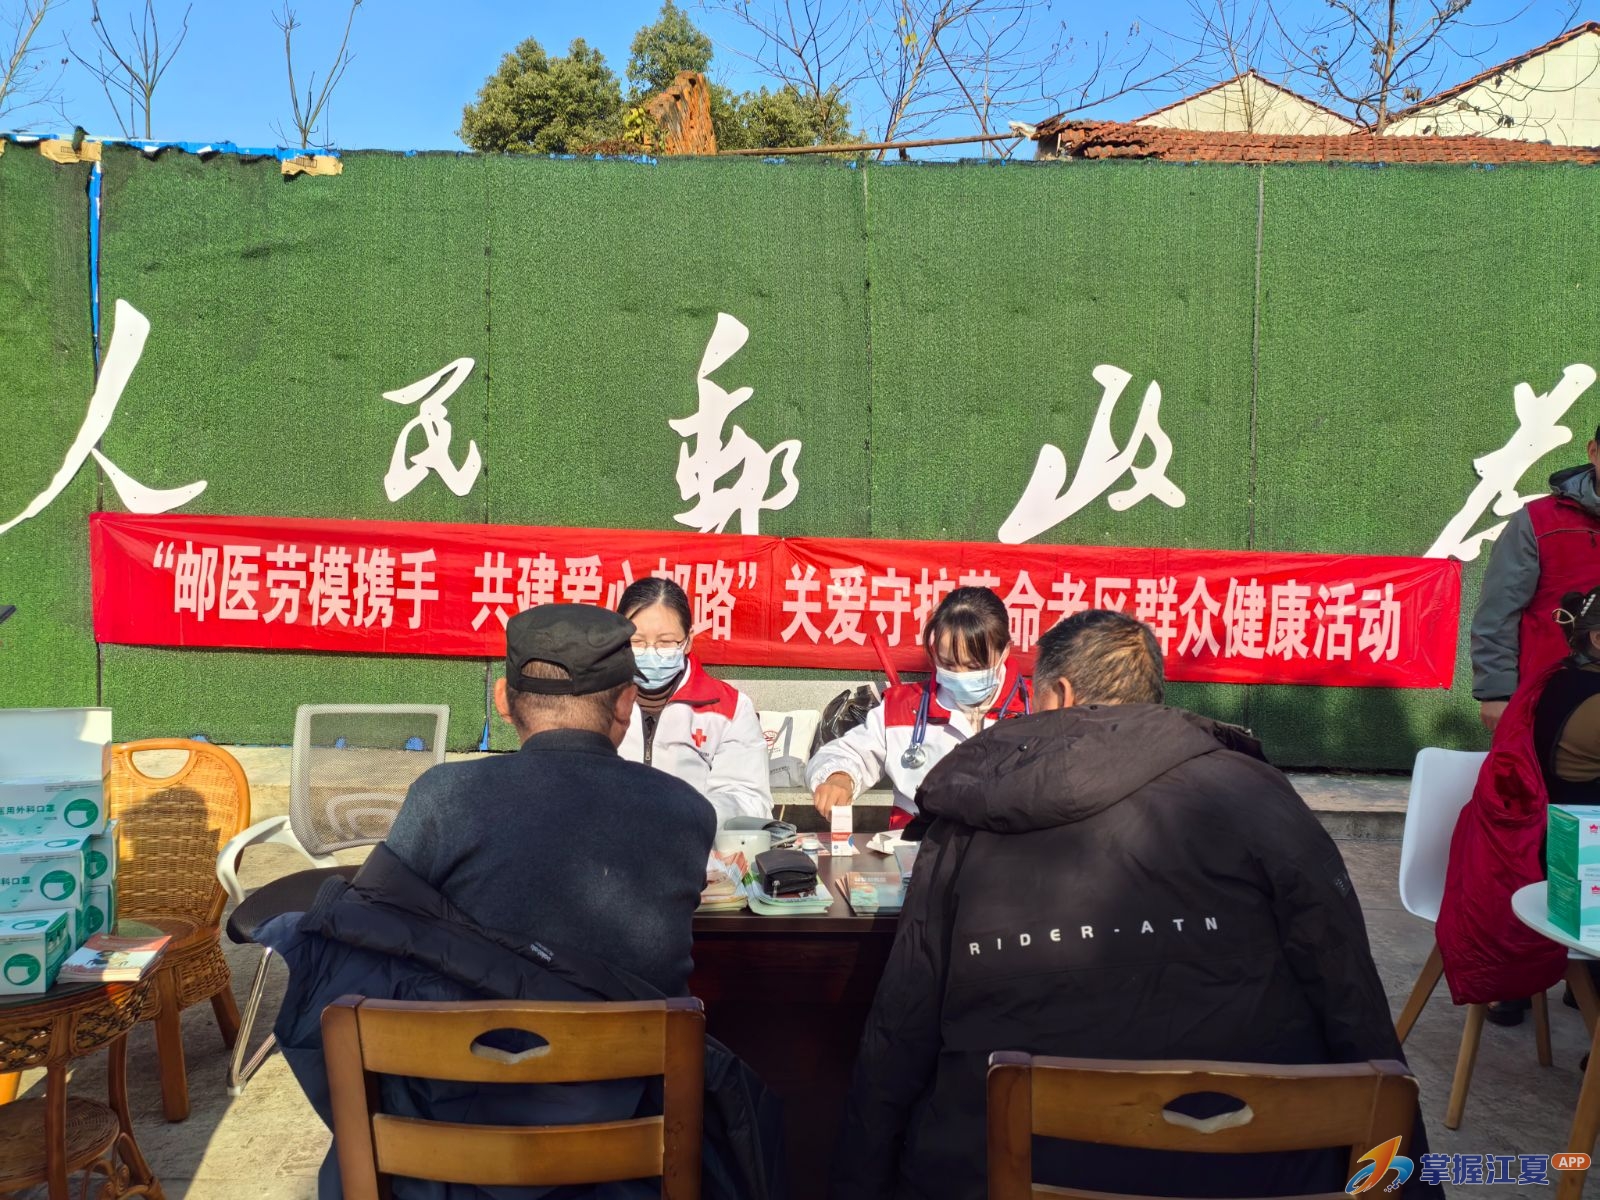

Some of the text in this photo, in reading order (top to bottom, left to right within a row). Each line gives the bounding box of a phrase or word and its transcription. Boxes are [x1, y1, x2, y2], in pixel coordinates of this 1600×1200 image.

[152, 540, 439, 630] “邮医劳模携手
[780, 563, 1401, 664] 关爱守护命老群众健康活动
